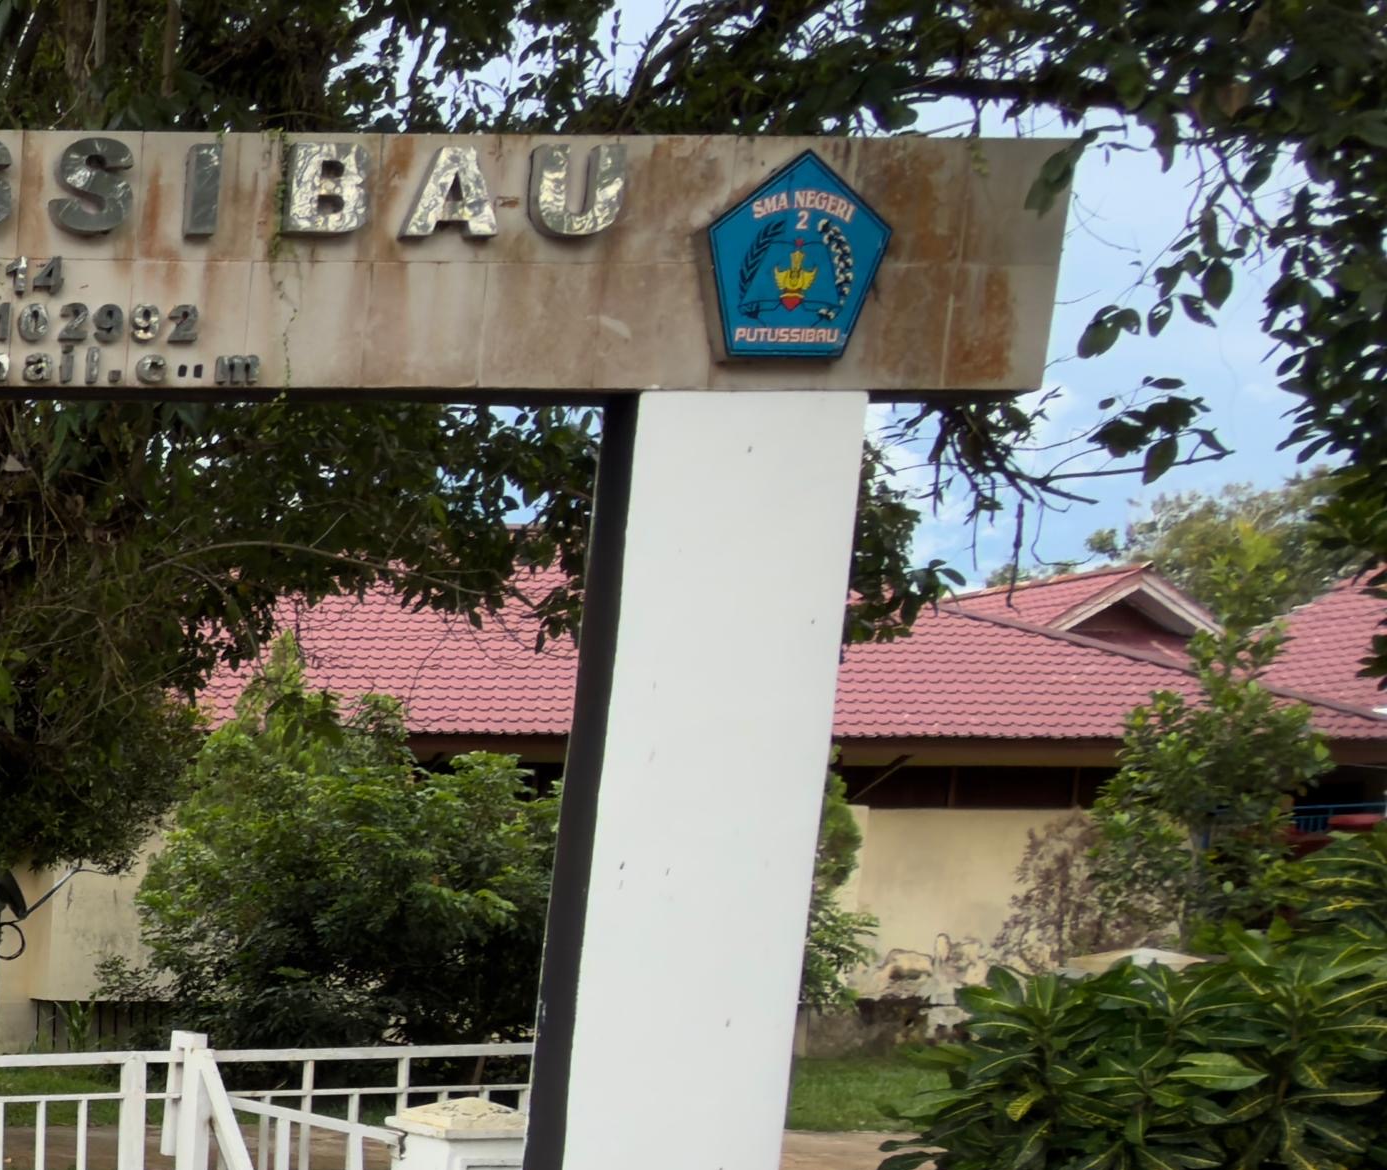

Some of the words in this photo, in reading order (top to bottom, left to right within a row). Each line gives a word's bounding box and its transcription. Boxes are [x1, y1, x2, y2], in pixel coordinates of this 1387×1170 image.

[752, 192, 790, 219] SMA
[794, 190, 857, 223] NEGERI
[795, 210, 809, 230] 2
[734, 327, 840, 343] PUTUSSIBAU
